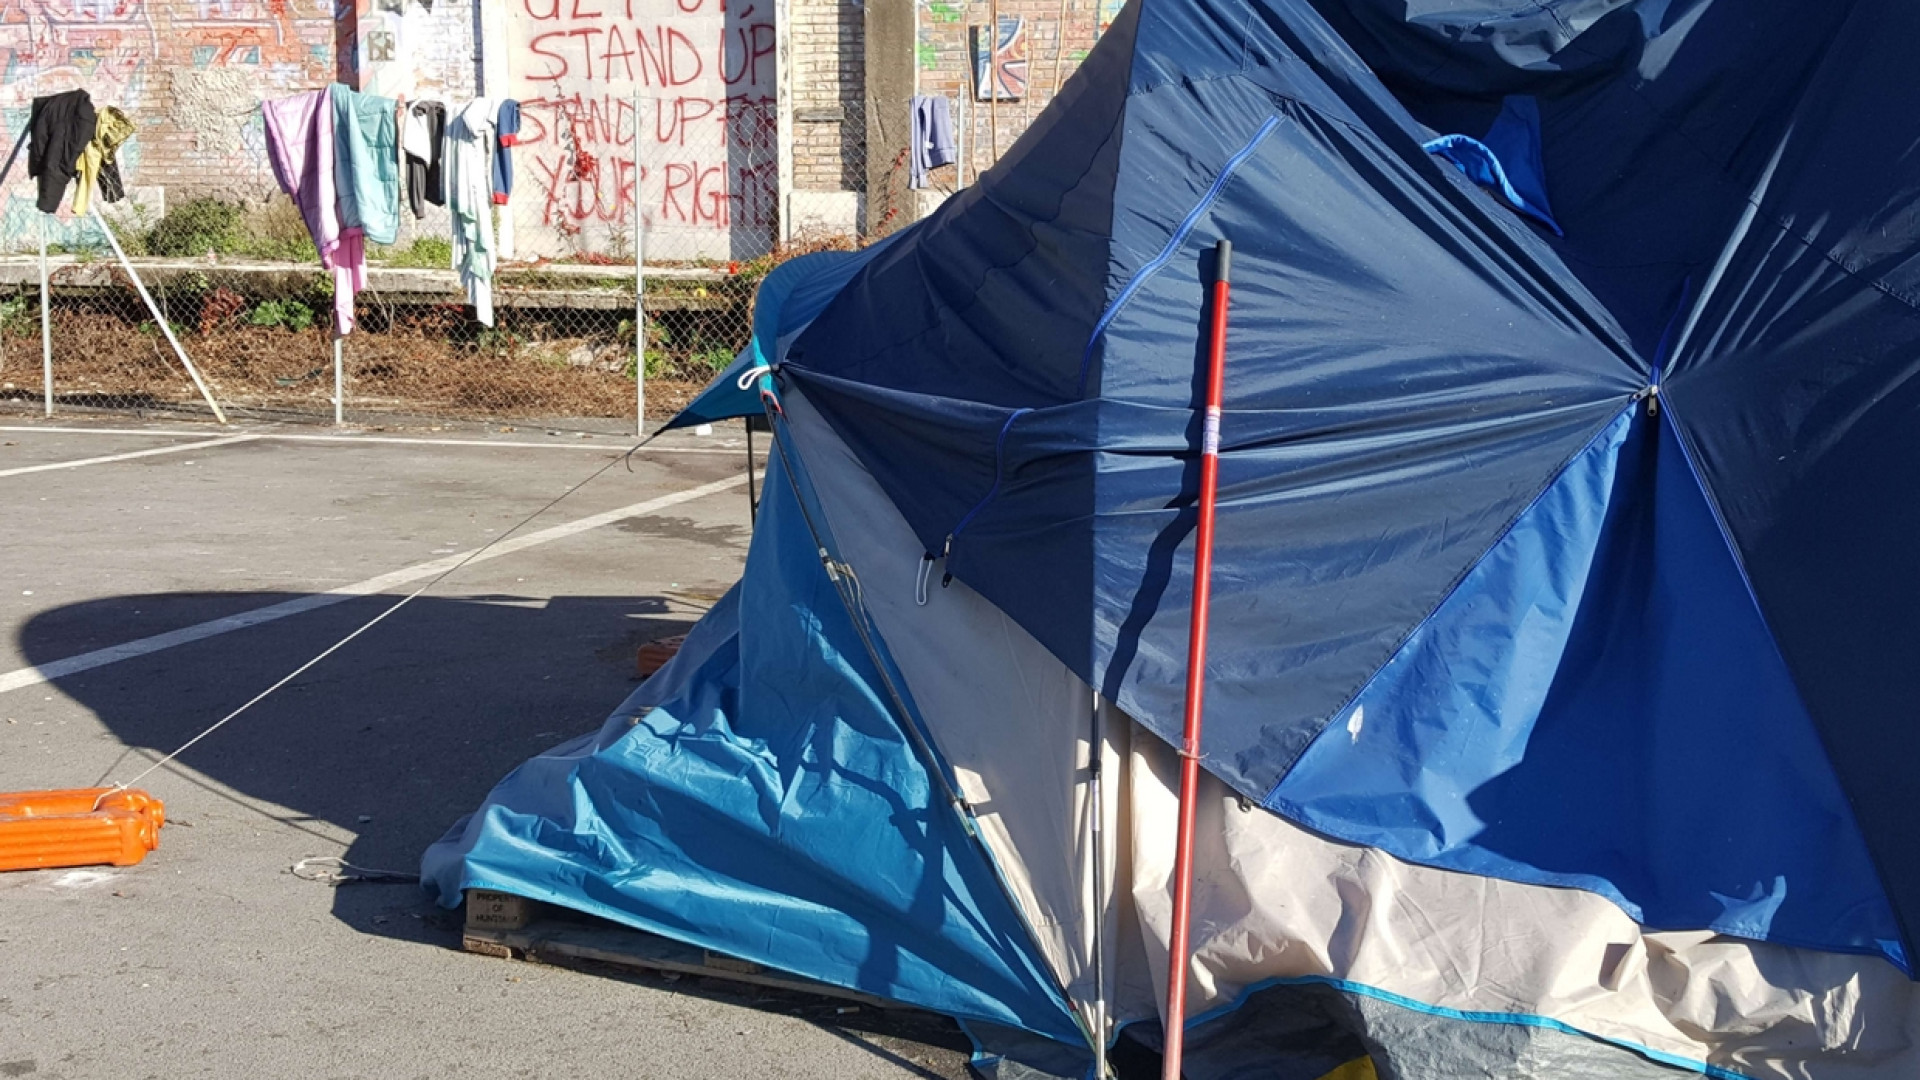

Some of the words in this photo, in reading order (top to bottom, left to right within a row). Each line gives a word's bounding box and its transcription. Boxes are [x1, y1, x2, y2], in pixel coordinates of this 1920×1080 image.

[525, 24, 702, 87] STAND
[718, 23, 777, 85] UP
[517, 92, 637, 146] STAND
[656, 96, 714, 146] UP
[536, 155, 648, 225] YOUR
